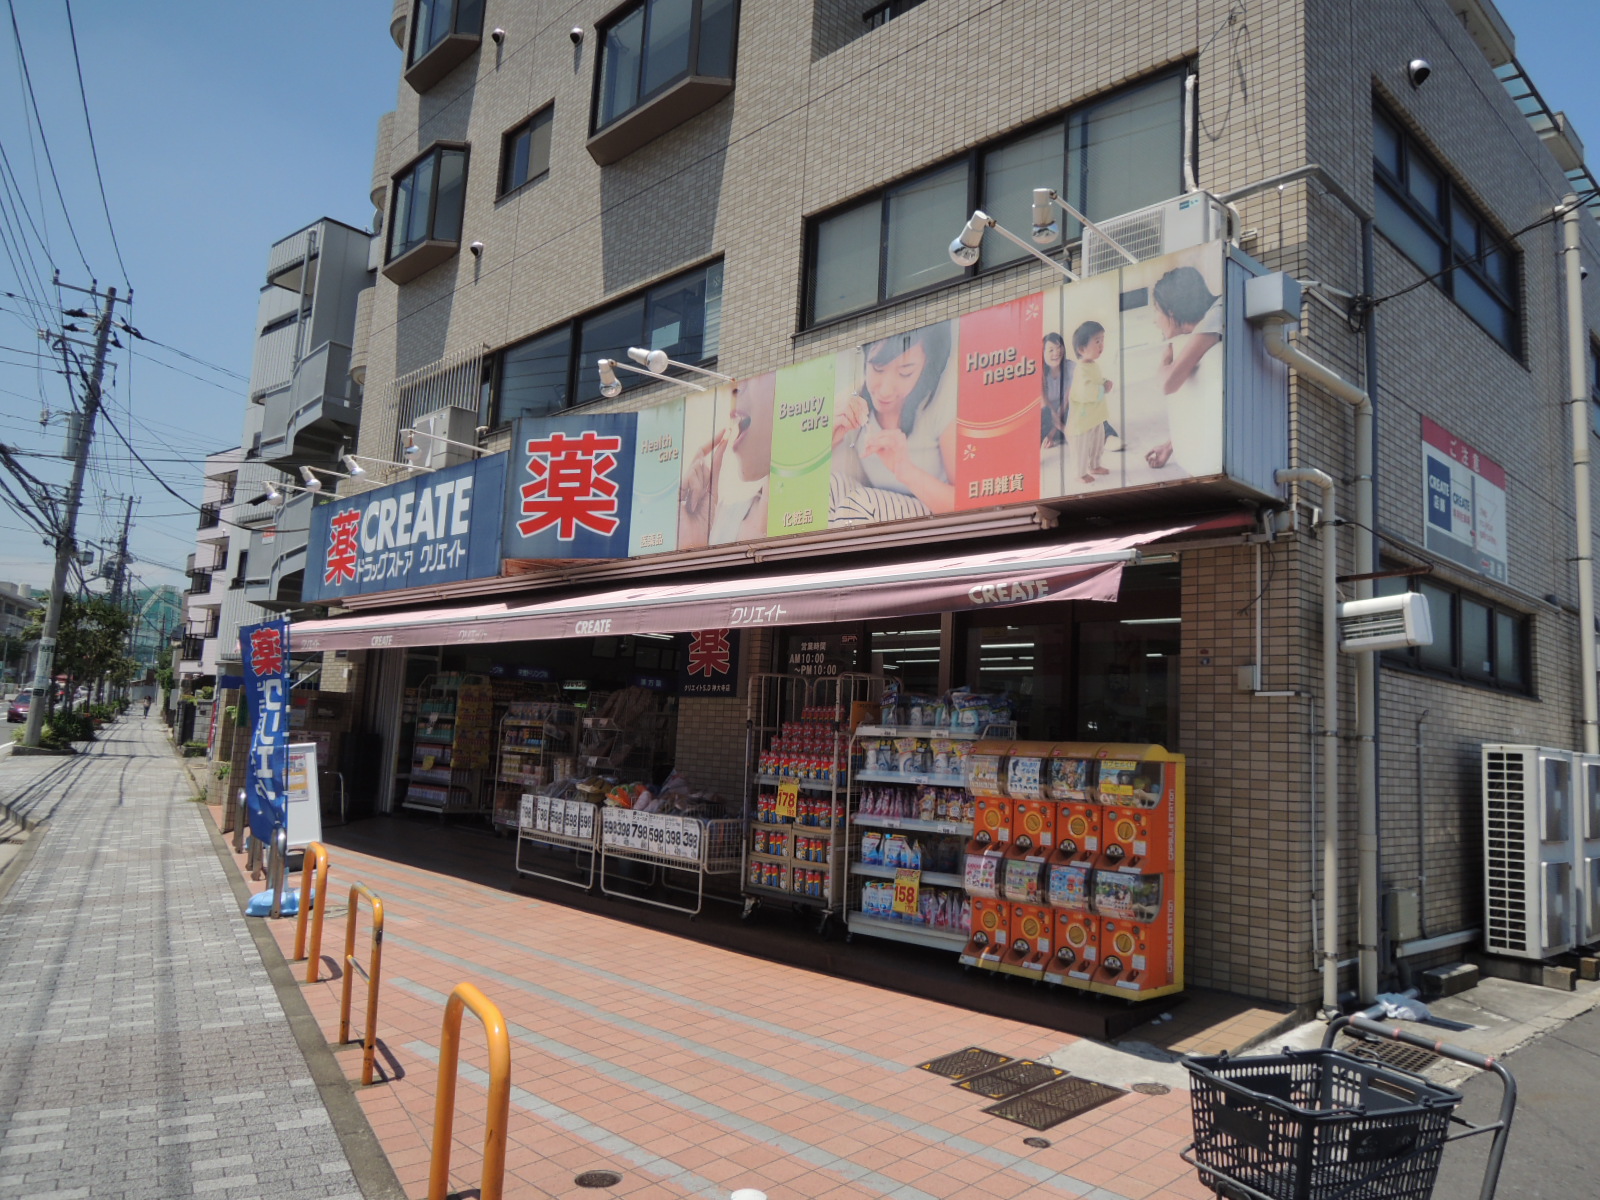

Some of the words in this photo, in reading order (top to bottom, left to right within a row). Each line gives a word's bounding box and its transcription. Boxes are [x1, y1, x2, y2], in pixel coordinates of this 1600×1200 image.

[965, 345, 1017, 373] Home
[983, 356, 1036, 386] needs
[779, 396, 826, 419] Beauty
[801, 413, 829, 432] care
[640, 433, 673, 454] Health
[659, 447, 679, 463] care
[516, 431, 620, 540] 薬
[361, 475, 473, 552] CREATE
[783, 509, 813, 527] 化粧品
[325, 508, 361, 586] 薬
[419, 539, 466, 574] クリエイト
[967, 579, 1049, 605] CREATE
[730, 605, 787, 625] クリエイト
[575, 618, 612, 634] CREATE
[371, 634, 393, 648] CREATE
[778, 791, 795, 808] 178
[565, 813, 578, 827] 598
[604, 820, 617, 834] 598
[617, 822, 630, 837] 398
[632, 824, 648, 839] 798
[649, 828, 664, 843] 598
[666, 830, 681, 845] 398
[683, 832, 698, 849] 398
[895, 885, 914, 903] 158
